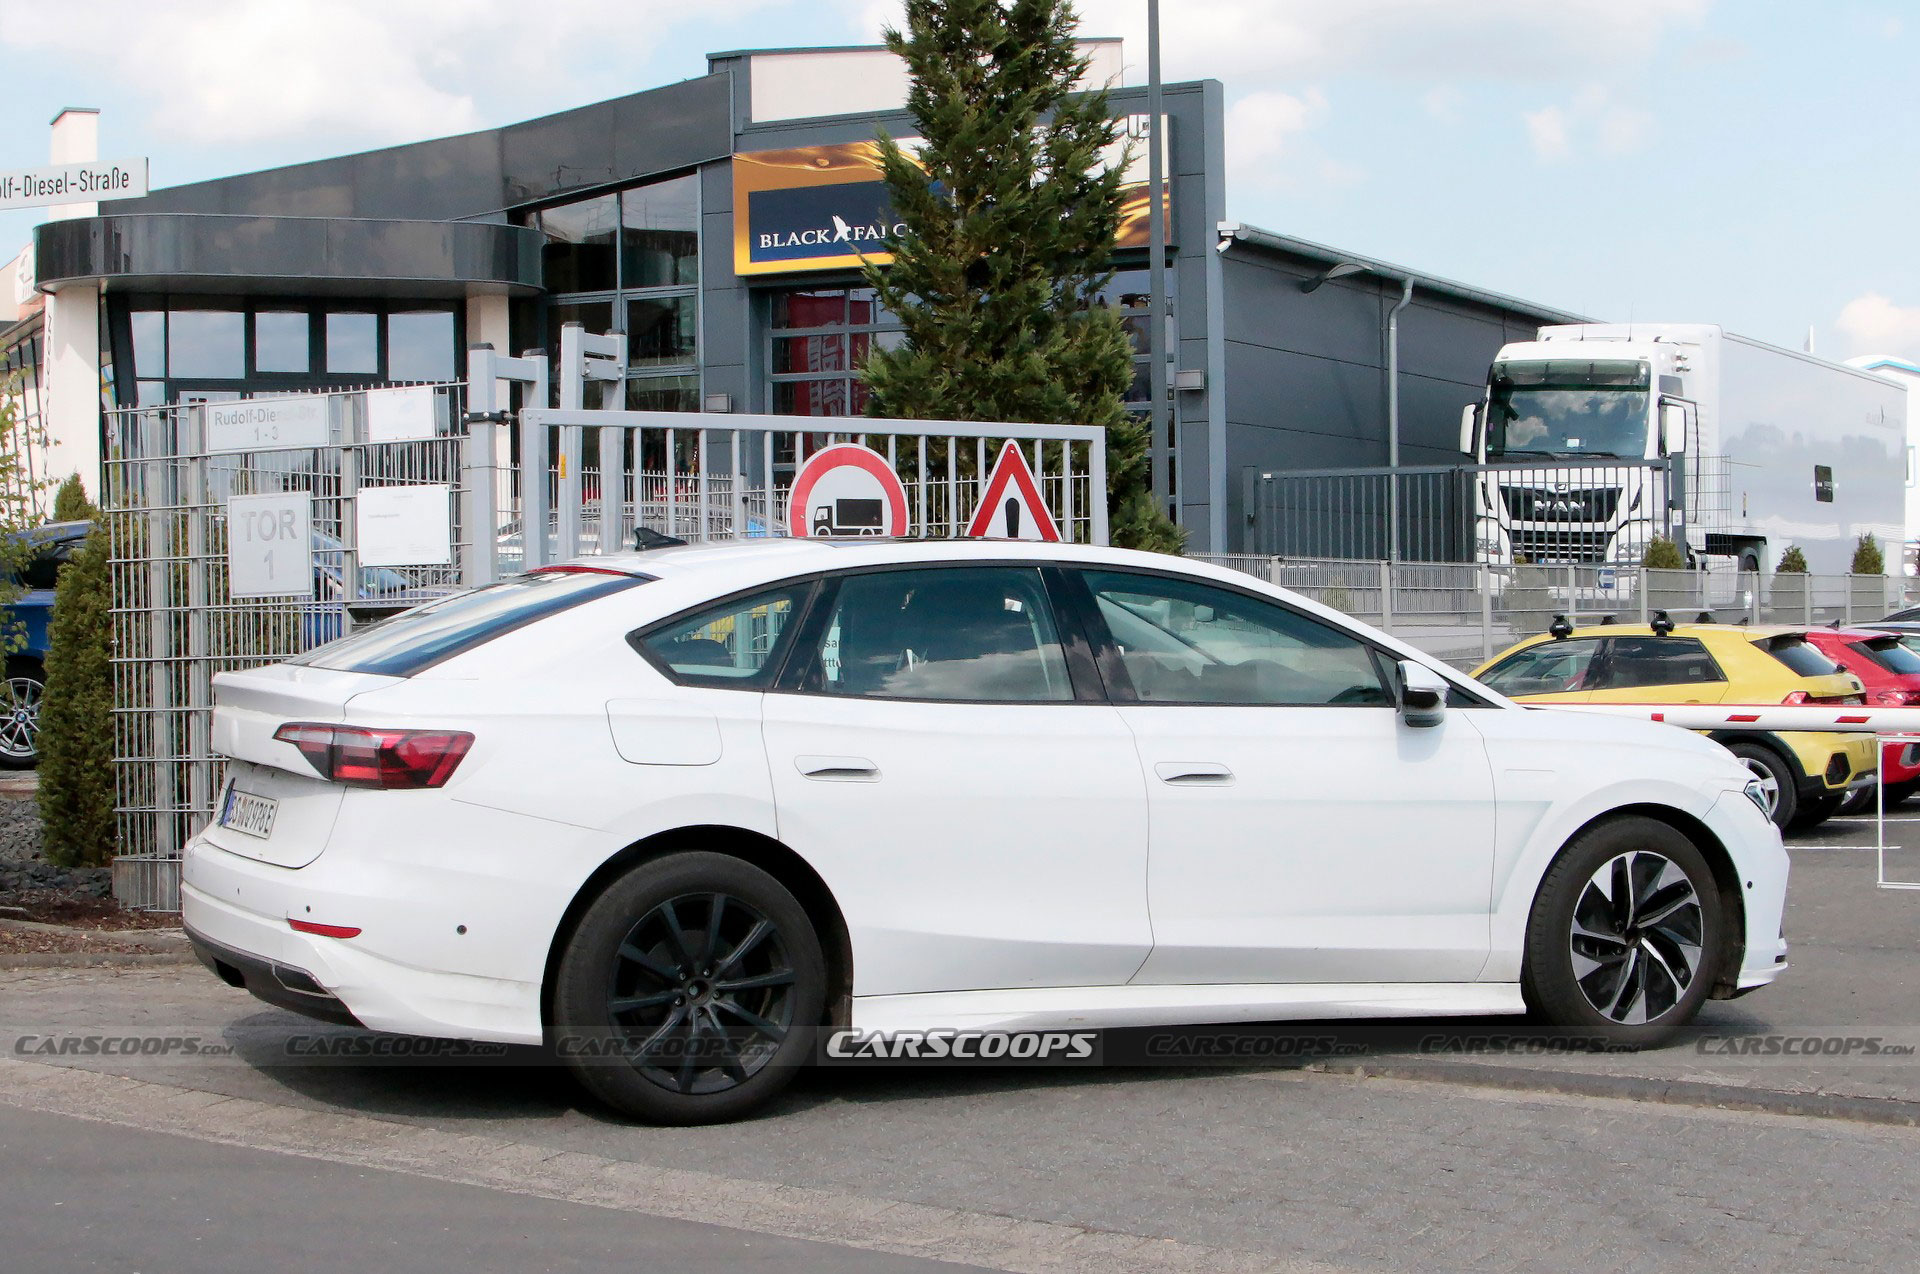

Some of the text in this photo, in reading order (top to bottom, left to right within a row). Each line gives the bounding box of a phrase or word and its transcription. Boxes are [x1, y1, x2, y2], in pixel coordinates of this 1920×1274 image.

[760, 229, 831, 249] BLACK
[272, 425, 279, 440] 3
[241, 509, 297, 542] TOR
[264, 549, 274, 580] 1
